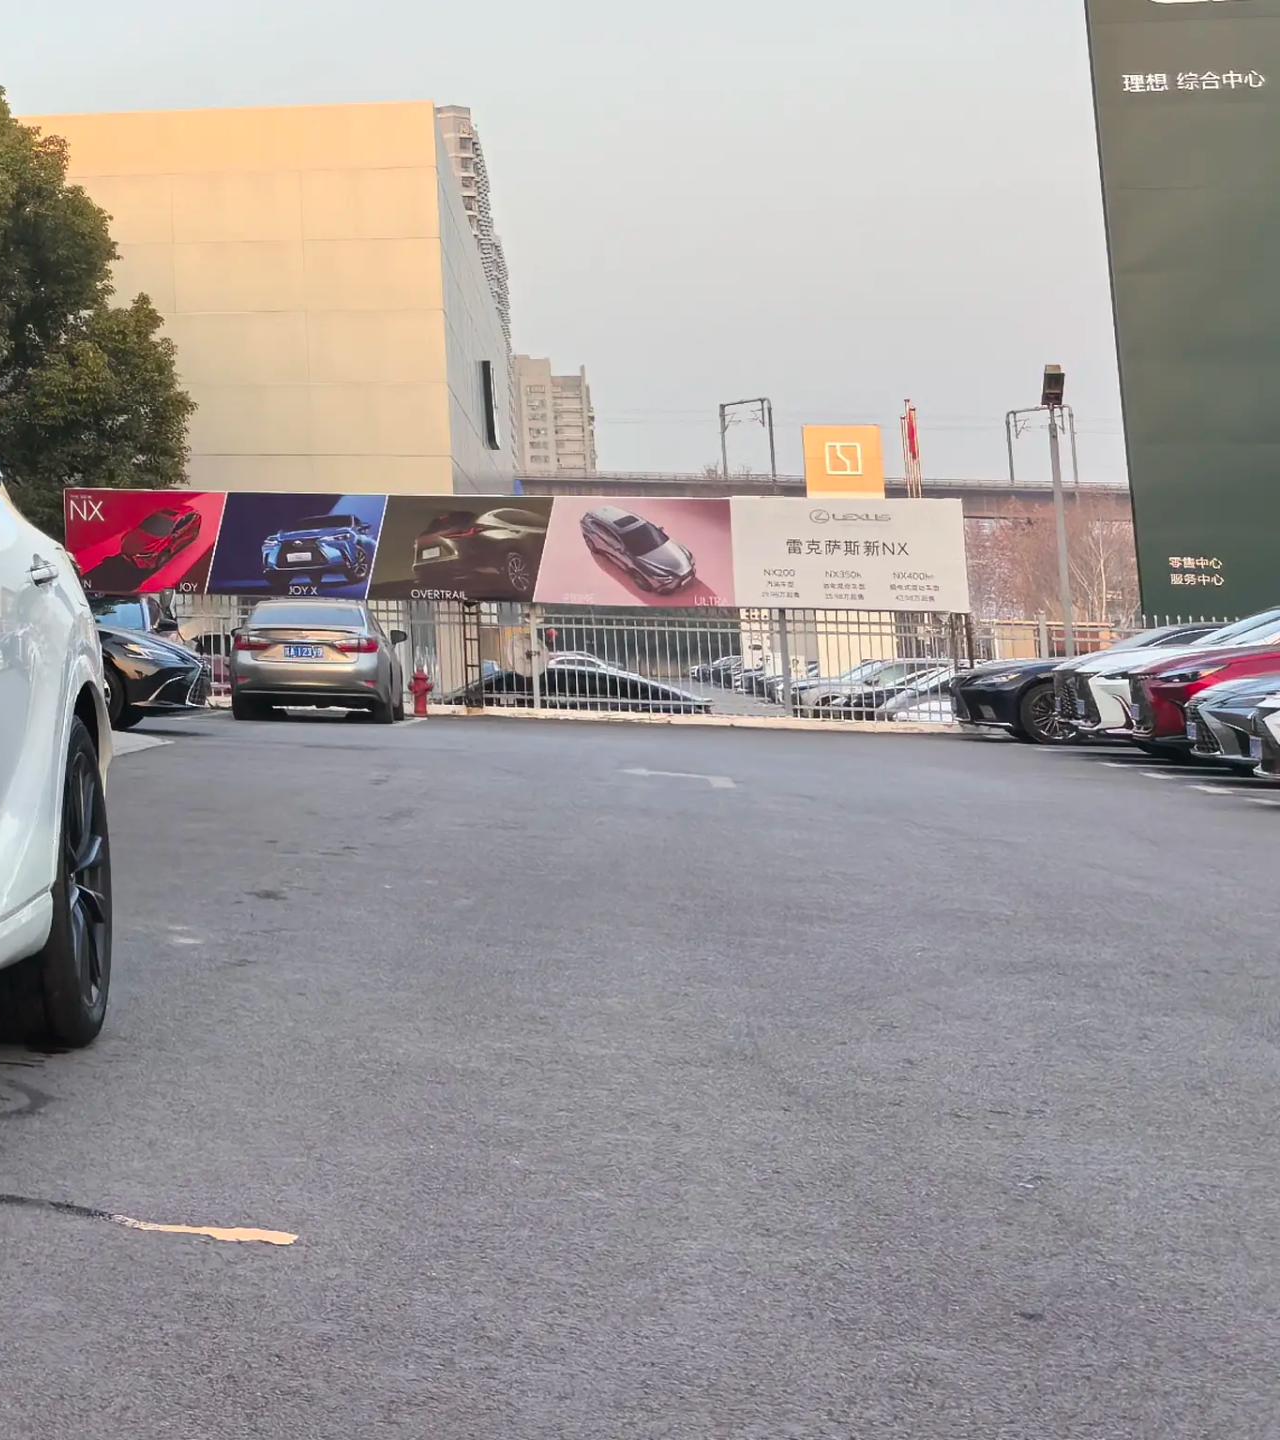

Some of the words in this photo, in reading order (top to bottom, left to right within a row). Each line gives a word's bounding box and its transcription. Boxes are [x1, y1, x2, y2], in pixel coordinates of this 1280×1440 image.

[1122, 73, 1169, 92] 理想
[1176, 70, 1265, 91] 综合中心
[69, 499, 105, 522] NX
[832, 512, 892, 522] LEXUS
[786, 538, 909, 556] 雷克萨斯新NX
[763, 568, 796, 577] NX200
[825, 570, 862, 579] NX350h
[179, 582, 198, 592] JOY
[288, 586, 308, 595] JOY
[309, 586, 317, 595] X
[410, 589, 468, 599] OVERTRAIL
[694, 595, 729, 607] ULTRA
